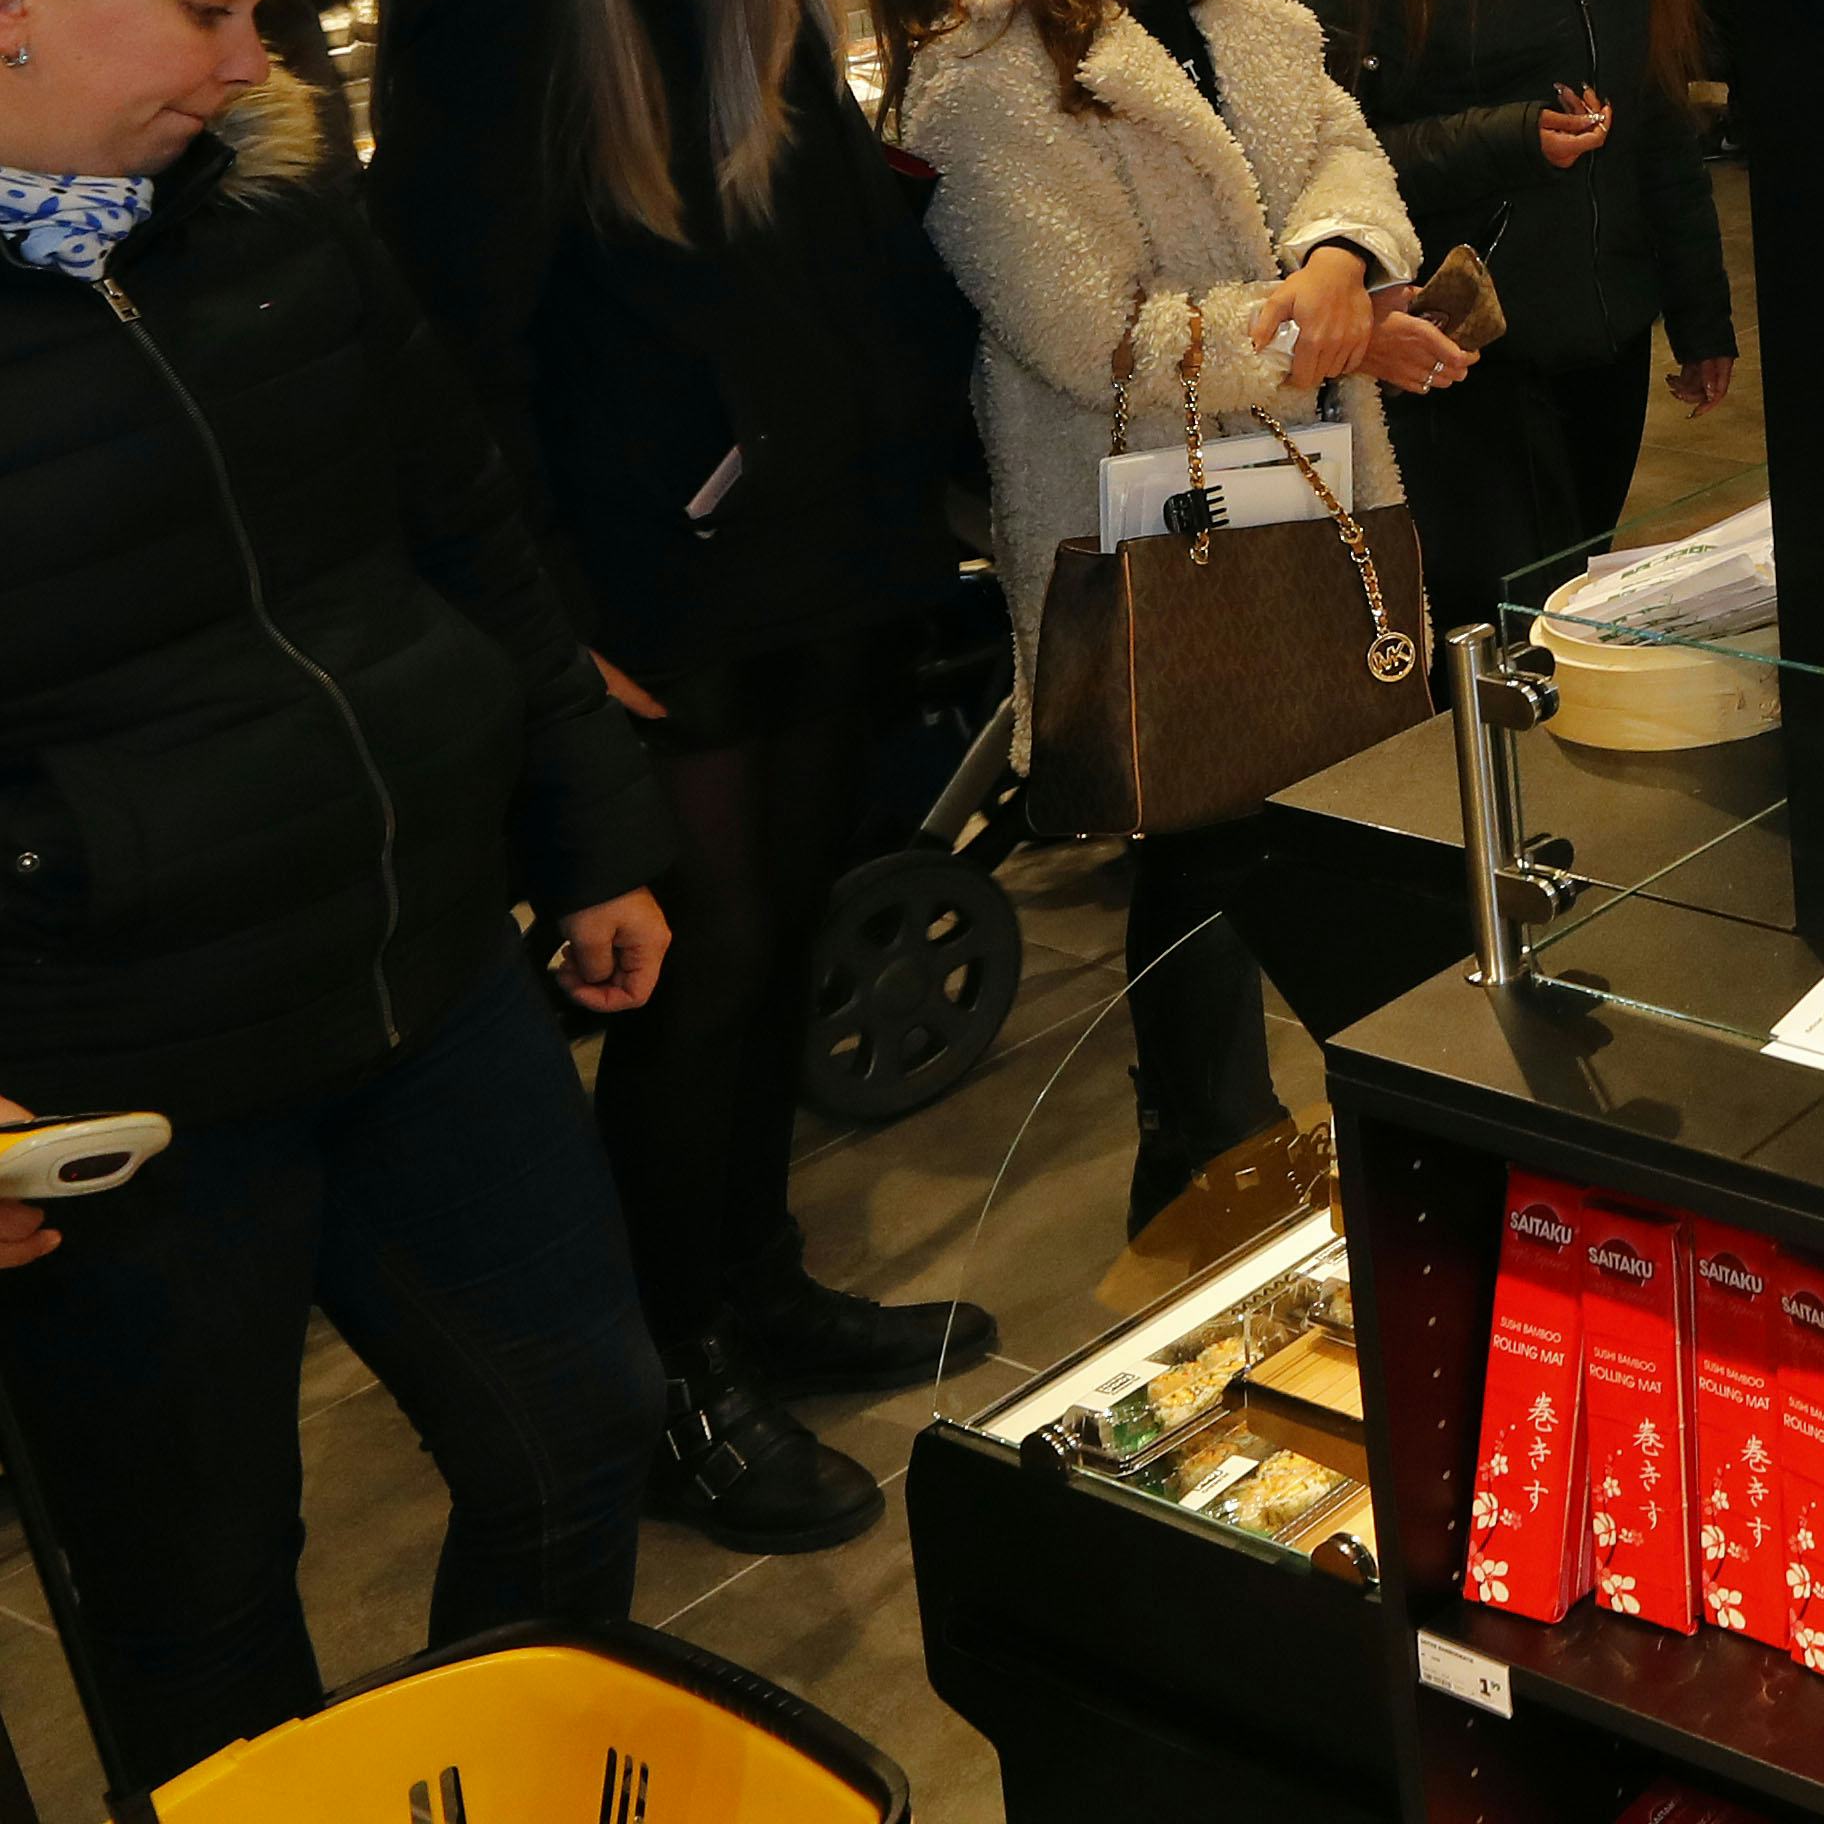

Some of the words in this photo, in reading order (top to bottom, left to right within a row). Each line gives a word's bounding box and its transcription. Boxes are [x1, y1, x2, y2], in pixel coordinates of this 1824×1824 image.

[1510, 1211, 1572, 1244] SAITAKU
[1588, 1246, 1653, 1279] SAITAKU
[1700, 1259, 1763, 1294] SAITAKU
[1501, 1316, 1522, 1335] SUSHI
[1523, 1323, 1562, 1344] BAMBOO
[1493, 1334, 1538, 1362] ROLLING
[1540, 1346, 1565, 1368] MAT
[1589, 1363, 1635, 1391] ROLLING
[1637, 1377, 1662, 1395] MAT
[1703, 1359, 1725, 1377] SUSHI
[1726, 1366, 1765, 1389] BAMBOO
[1699, 1376, 1744, 1405] ROLLING
[1745, 1390, 1771, 1411] MAT
[1522, 1391, 1559, 1514] 巻きす
[1633, 1417, 1666, 1532] 巻きす
[1740, 1433, 1773, 1549] 巻きす
